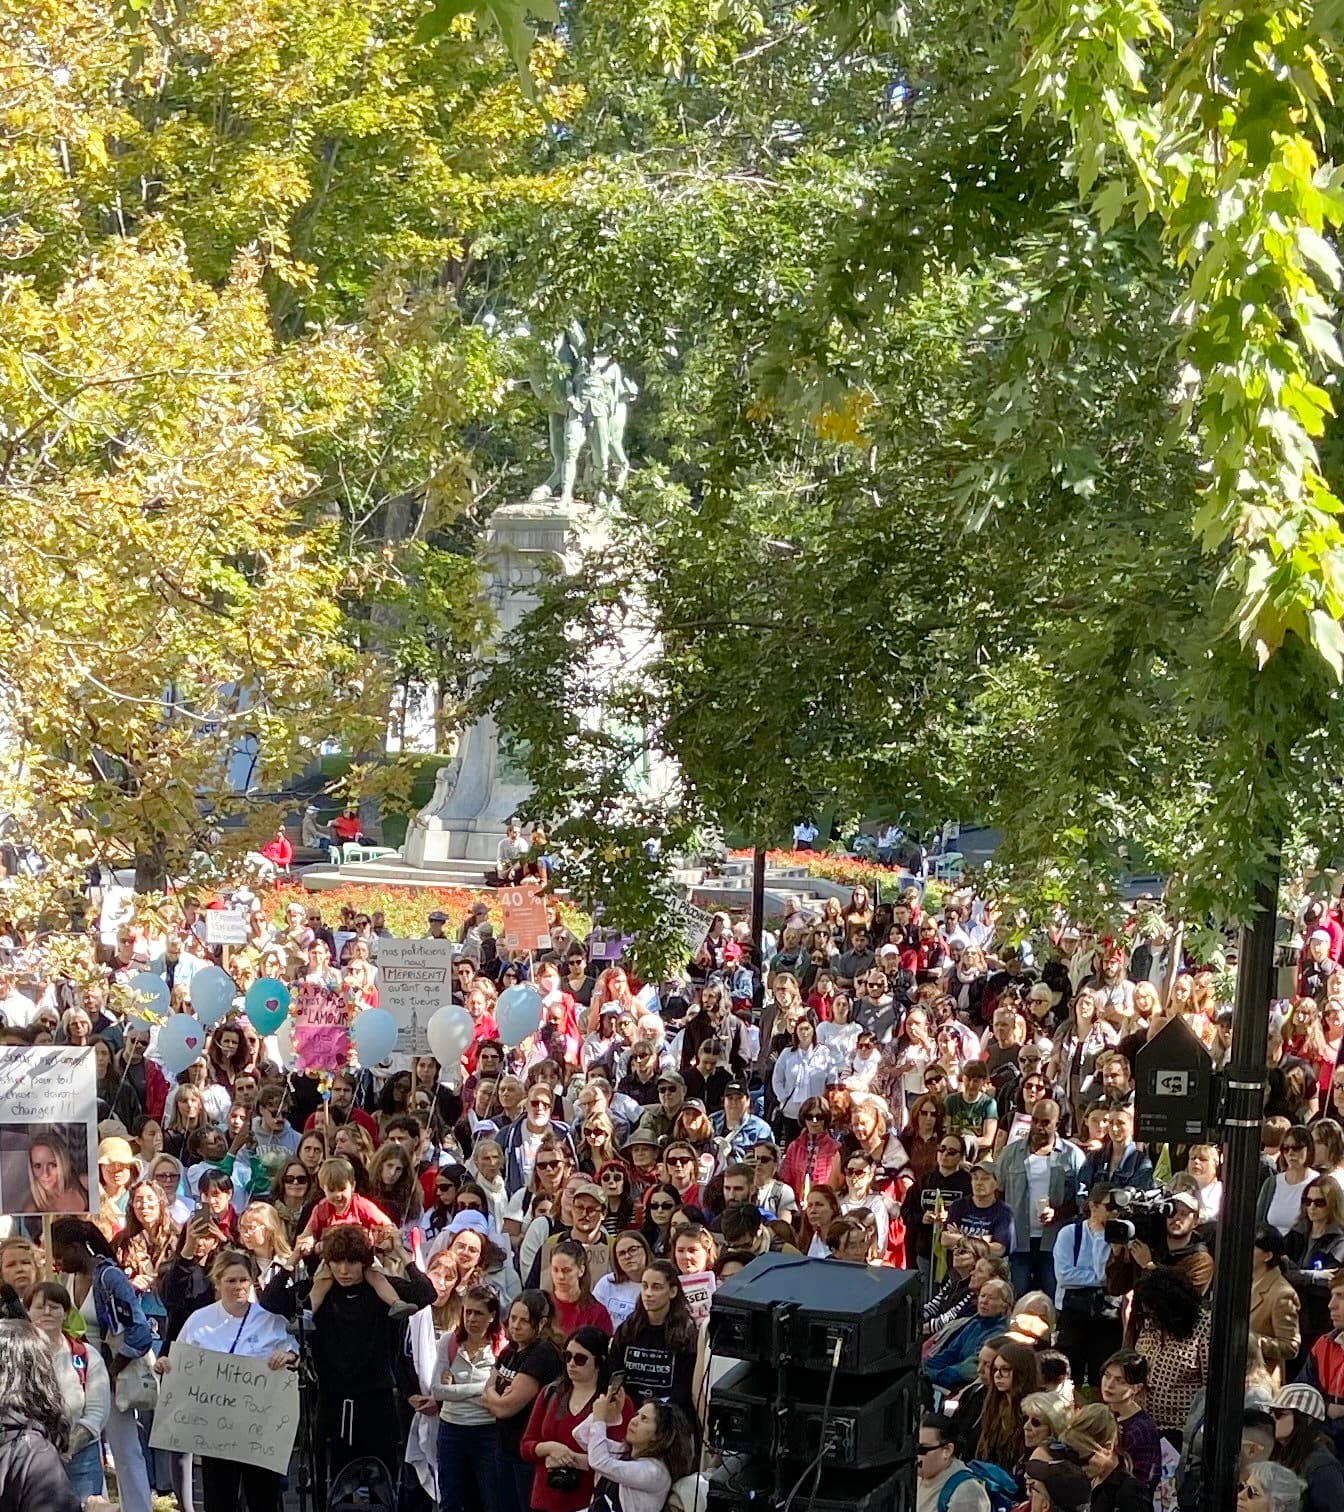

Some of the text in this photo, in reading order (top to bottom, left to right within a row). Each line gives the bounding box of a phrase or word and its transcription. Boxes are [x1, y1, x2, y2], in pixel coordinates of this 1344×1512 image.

[501, 892, 523, 907] 40
[382, 944, 446, 958] nos politiciens
[388, 983, 440, 997] autant que
[389, 996, 440, 1006] nos tueurs
[11, 1101, 54, 1119] changer
[177, 1358, 268, 1389] le Mitan
[188, 1385, 237, 1408] Marche
